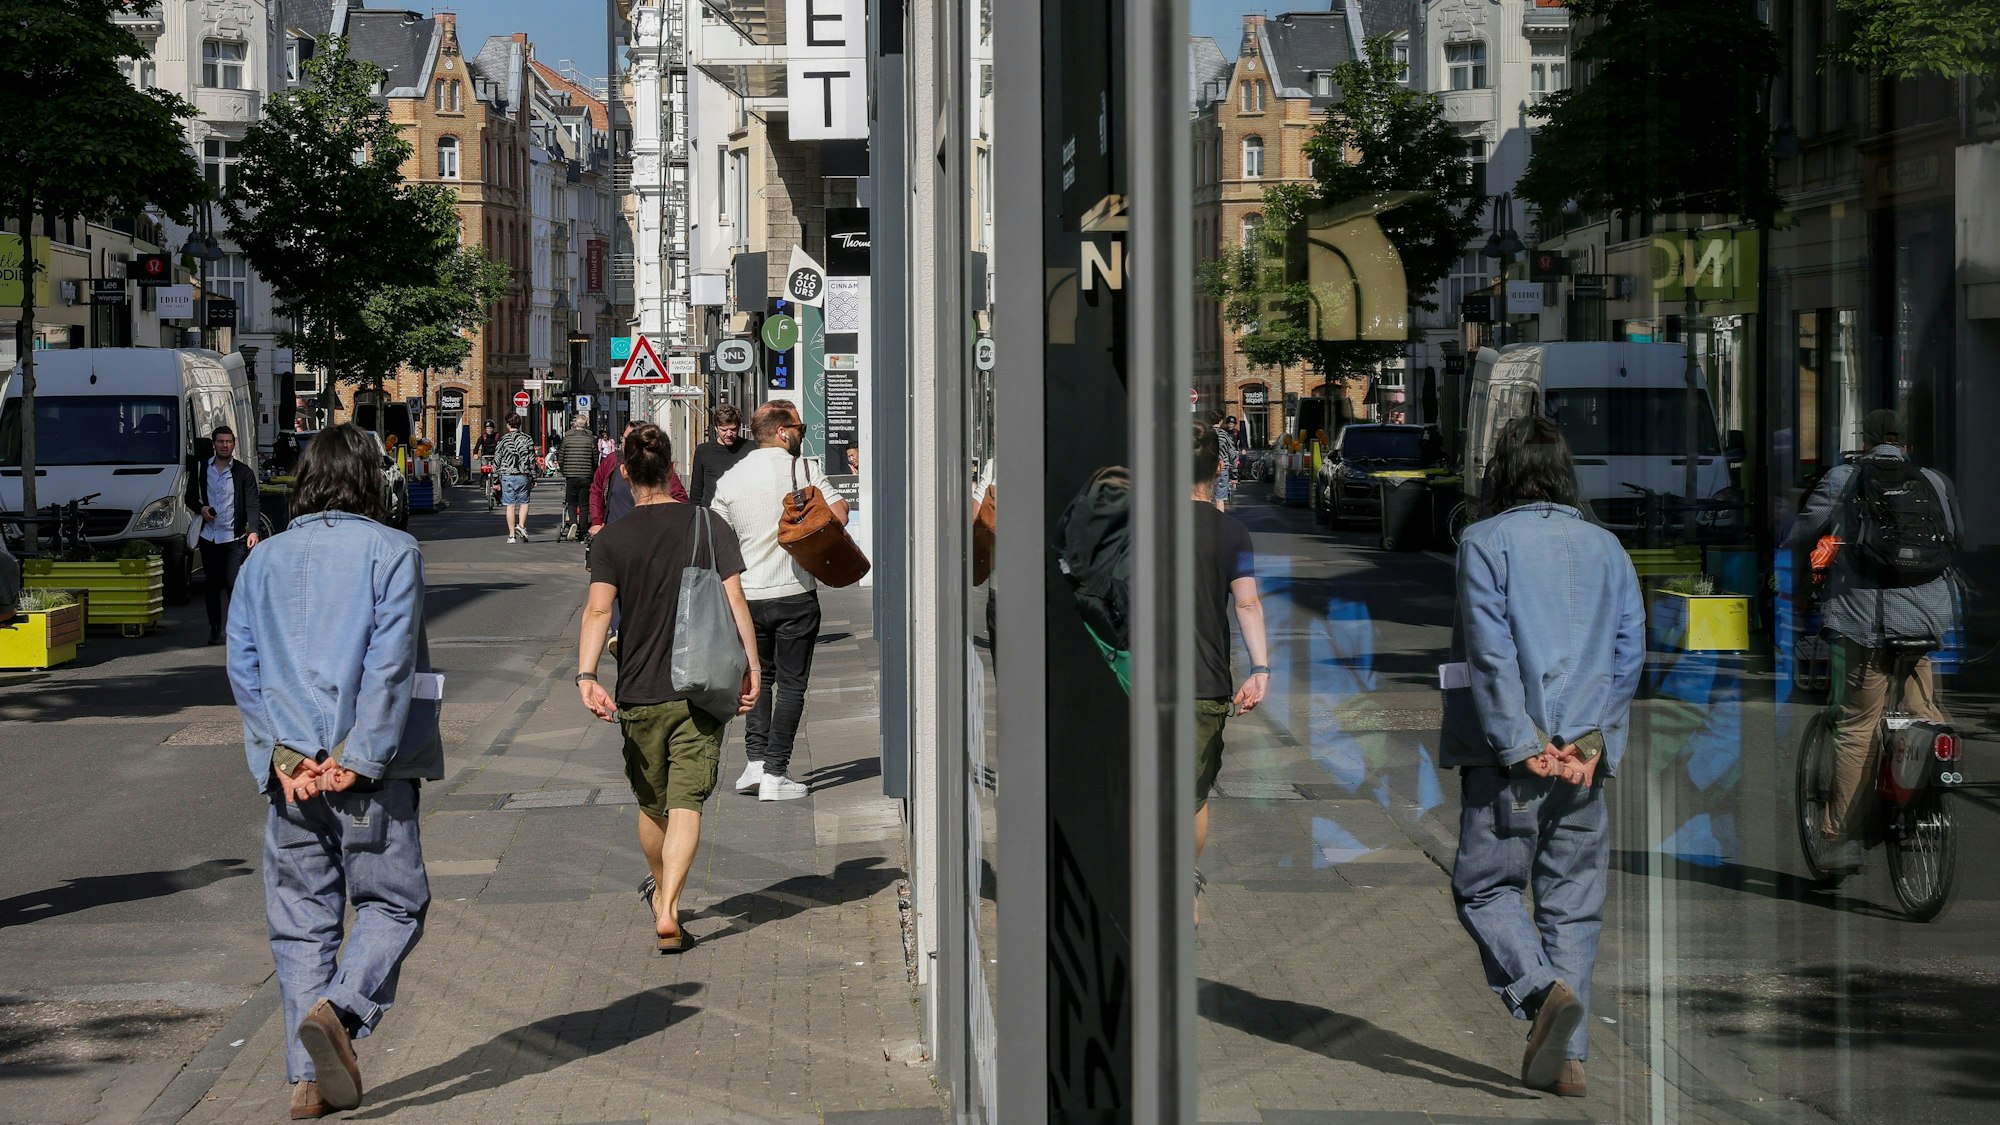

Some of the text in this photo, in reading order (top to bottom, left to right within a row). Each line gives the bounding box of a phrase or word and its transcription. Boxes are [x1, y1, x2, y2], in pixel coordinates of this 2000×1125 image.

[797, 271, 817, 282] 24C
[103, 281, 117, 289] Lee
[795, 279, 816, 289] OLO
[794, 286, 814, 297] URS
[210, 308, 234, 318] COS
[719, 351, 752, 360] ONLY
